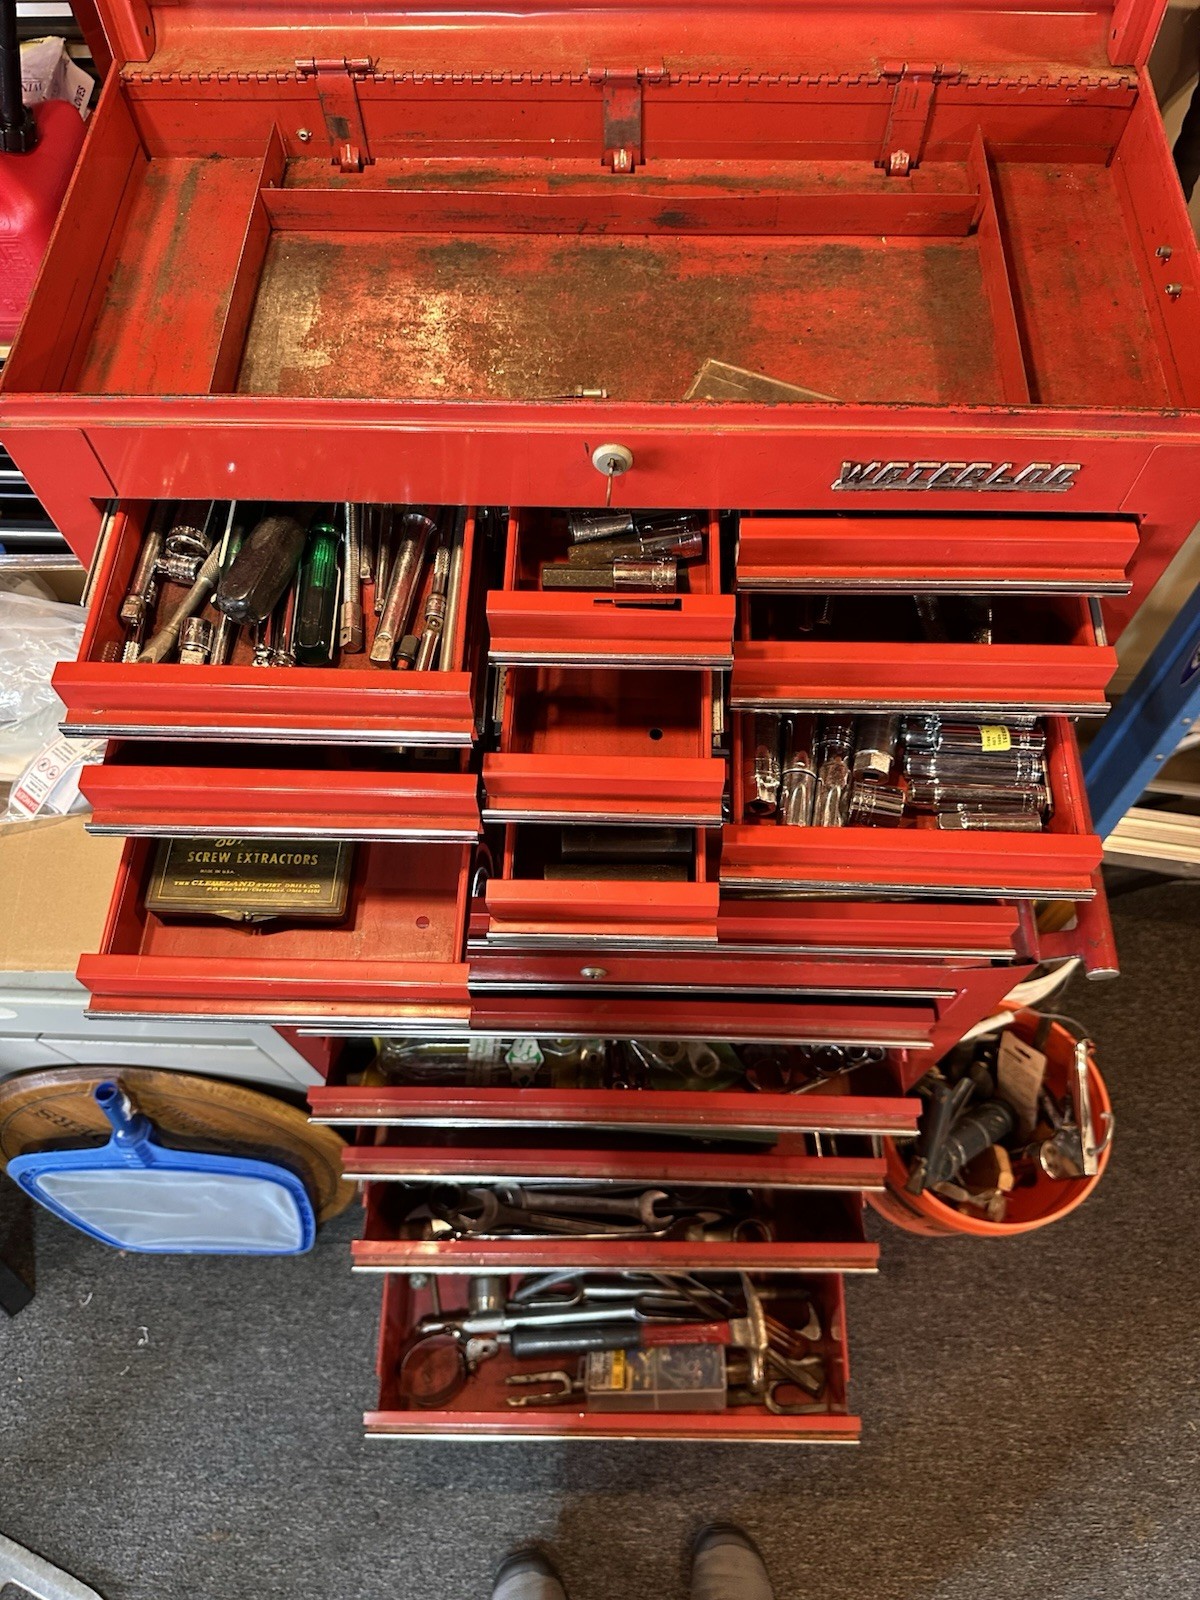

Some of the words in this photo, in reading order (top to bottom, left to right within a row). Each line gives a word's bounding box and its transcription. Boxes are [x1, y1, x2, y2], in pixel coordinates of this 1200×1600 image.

[830, 461, 1082, 492] WATERLOO
[186, 850, 232, 864] SCREW
[236, 852, 319, 866] EXTRACTORS
